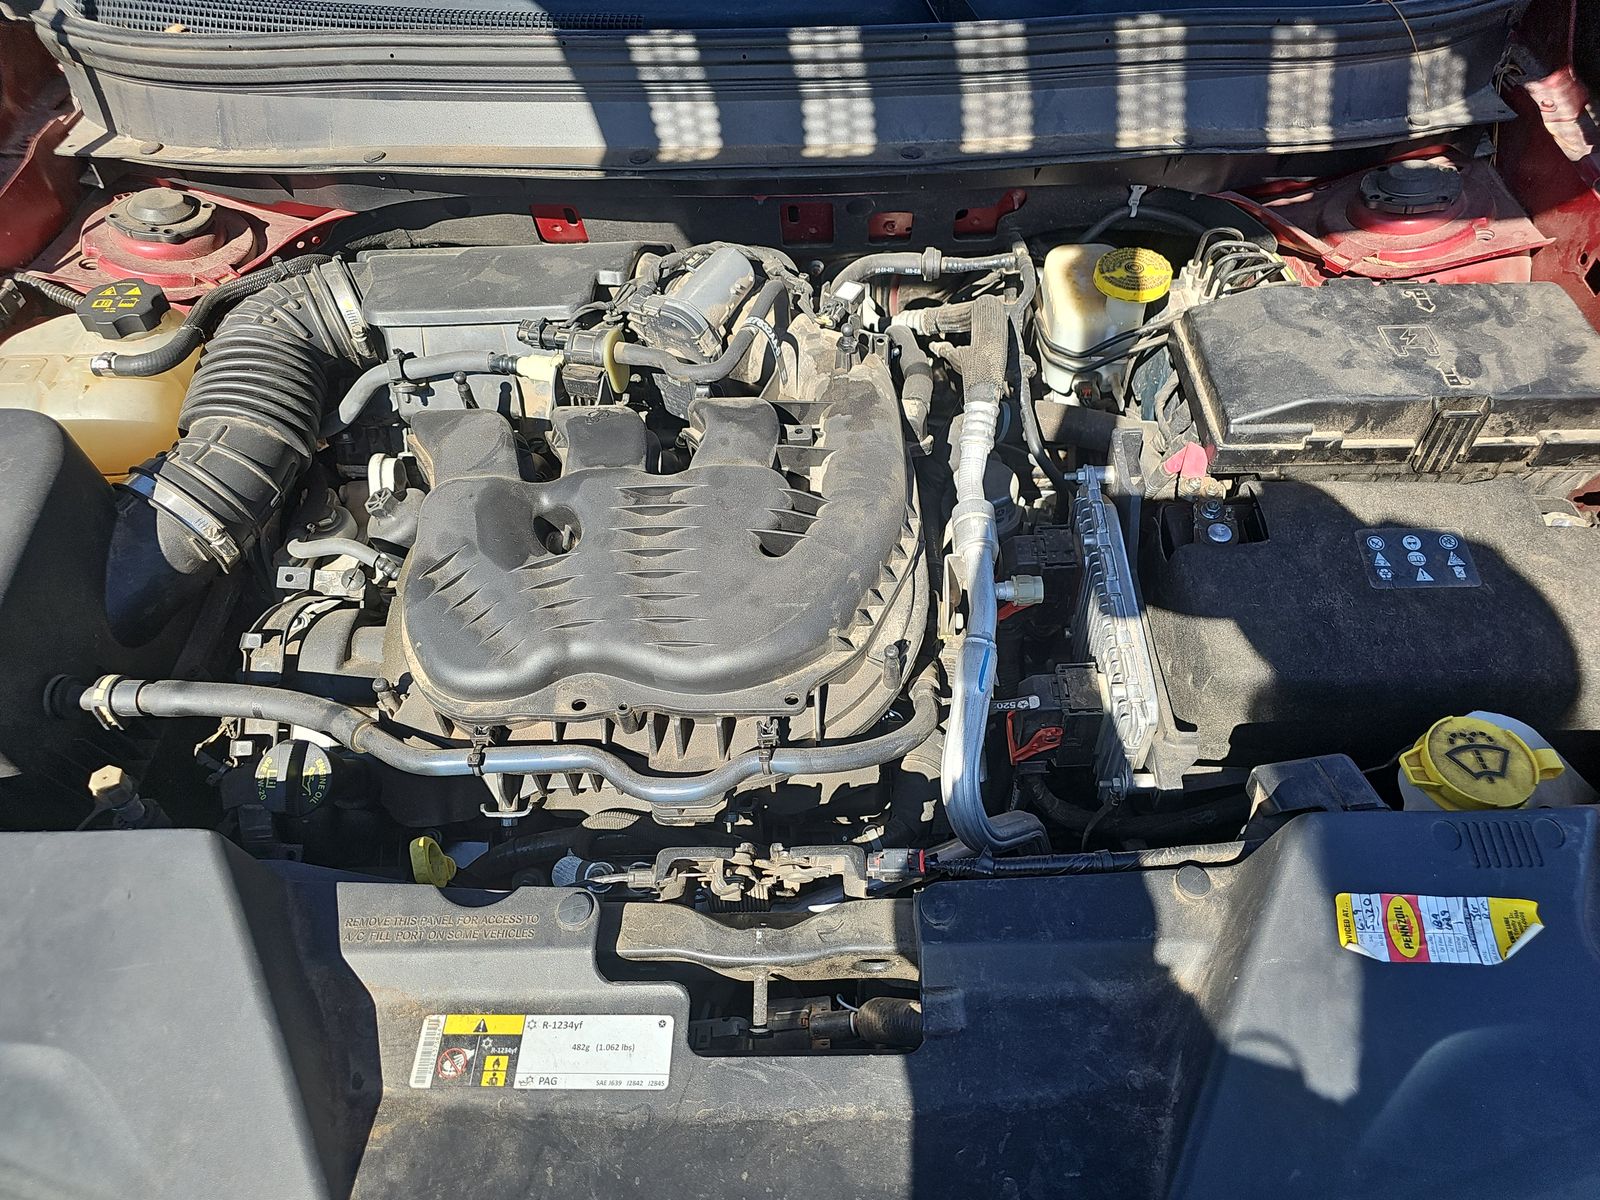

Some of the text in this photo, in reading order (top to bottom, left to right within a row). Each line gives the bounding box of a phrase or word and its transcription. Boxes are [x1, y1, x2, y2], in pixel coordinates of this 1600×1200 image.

[309, 758, 327, 804] ENGINE OIL
[345, 914, 540, 927] REMOVE THIS PANEL FOR ACCESS TO
[1344, 919, 1352, 944] RVICED
[1393, 905, 1414, 950] PENNZOIL
[343, 928, 535, 942] A/C FILL PORT ON SOME VEHICLES
[542, 1020, 583, 1031] R-1234yf
[572, 1043, 635, 1052] 482g (1.062 lbs)
[538, 1076, 558, 1086] PAG
